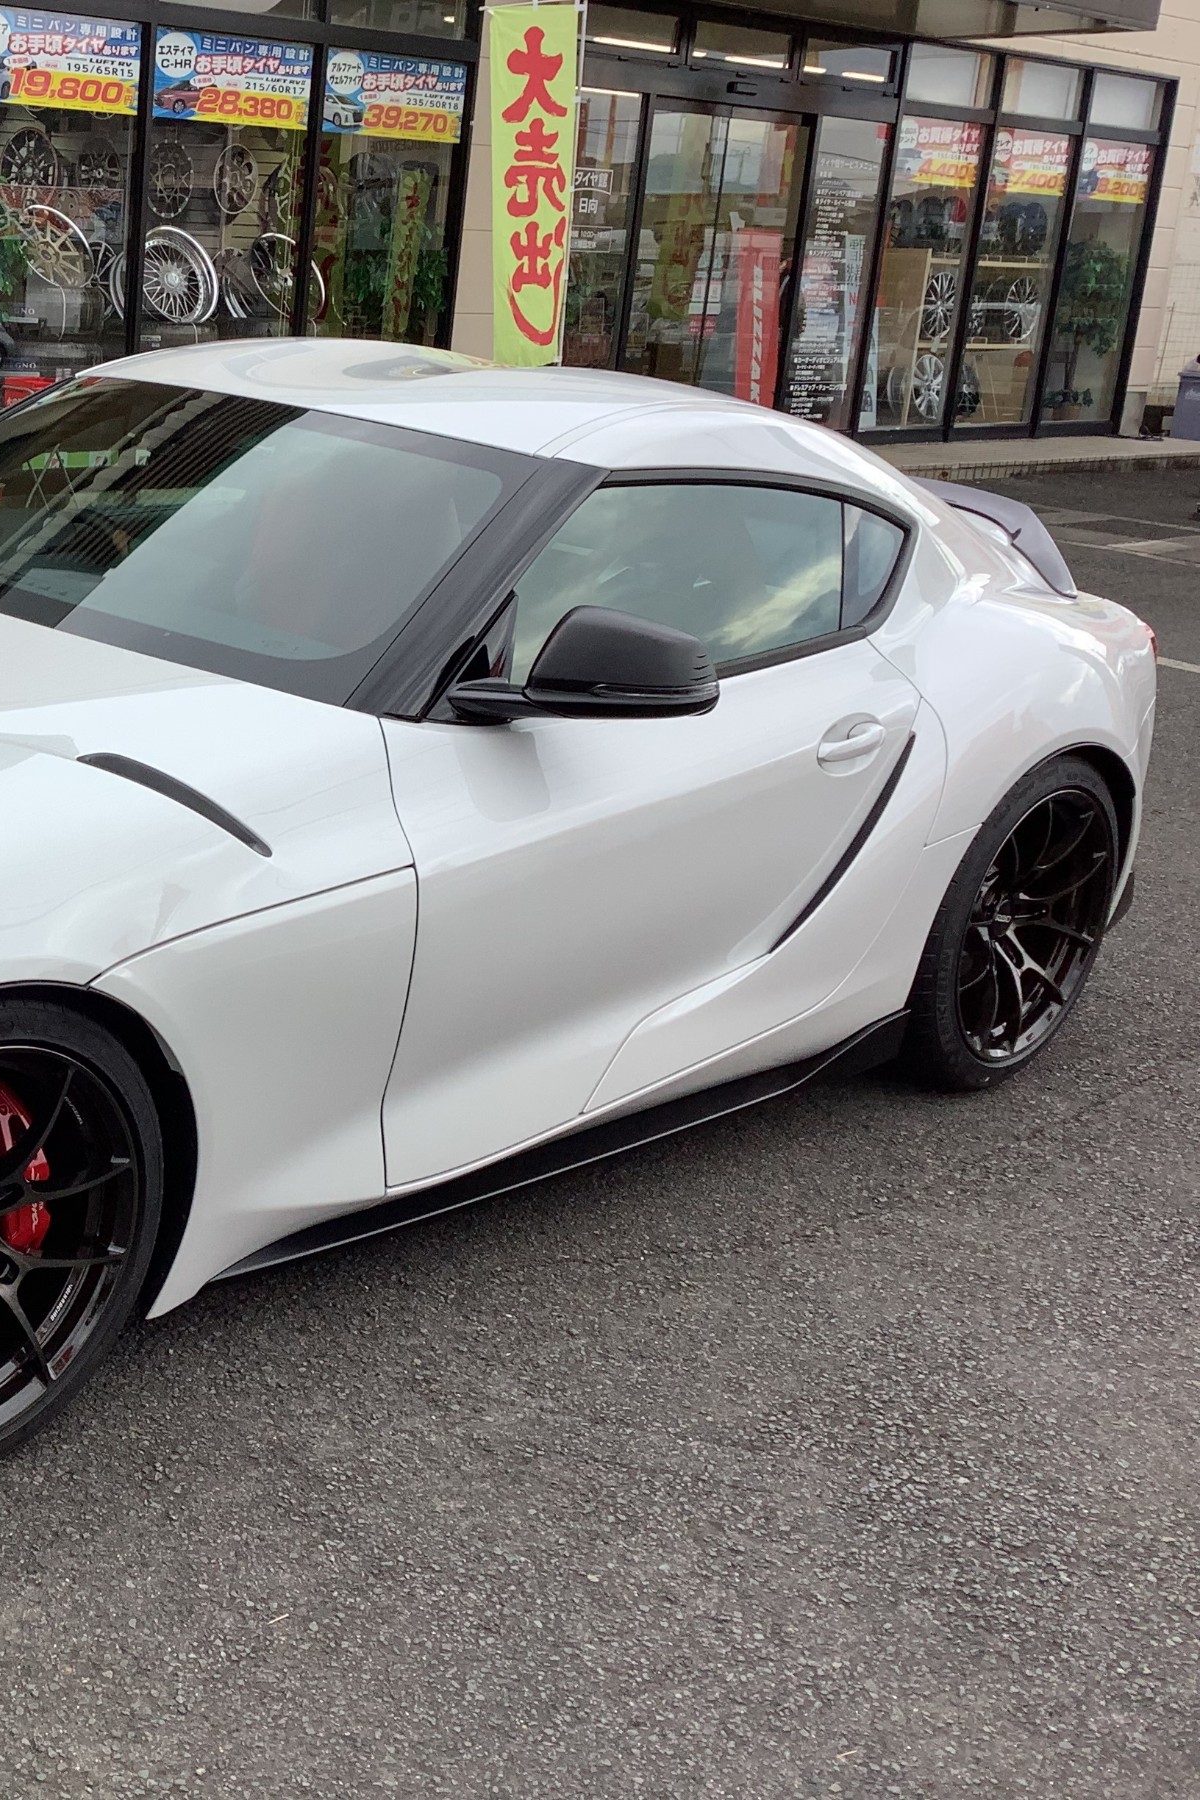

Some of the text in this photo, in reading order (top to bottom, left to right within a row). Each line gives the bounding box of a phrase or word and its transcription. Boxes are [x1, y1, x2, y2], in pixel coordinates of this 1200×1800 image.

[17, 15, 137, 42] ミニバン専用設計
[202, 37, 310, 61] ミニバン専用設計
[66, 62, 134, 78] 195/65R15
[161, 59, 192, 69] C-HR
[331, 63, 361, 73] アルファード
[369, 57, 464, 77] ミニバン専用設計
[10, 69, 124, 103] 19,800
[245, 81, 305, 95] 215/60R17
[329, 75, 362, 85] ヴェルファイア
[197, 88, 293, 119] 28,380
[406, 98, 459, 110] 235/50R18
[364, 104, 448, 133] 39,270
[502, 26, 568, 346] 大売出し
[575, 172, 608, 188] タイヤ館
[579, 198, 598, 214] 日向
[750, 265, 764, 404] BLIZZAK
